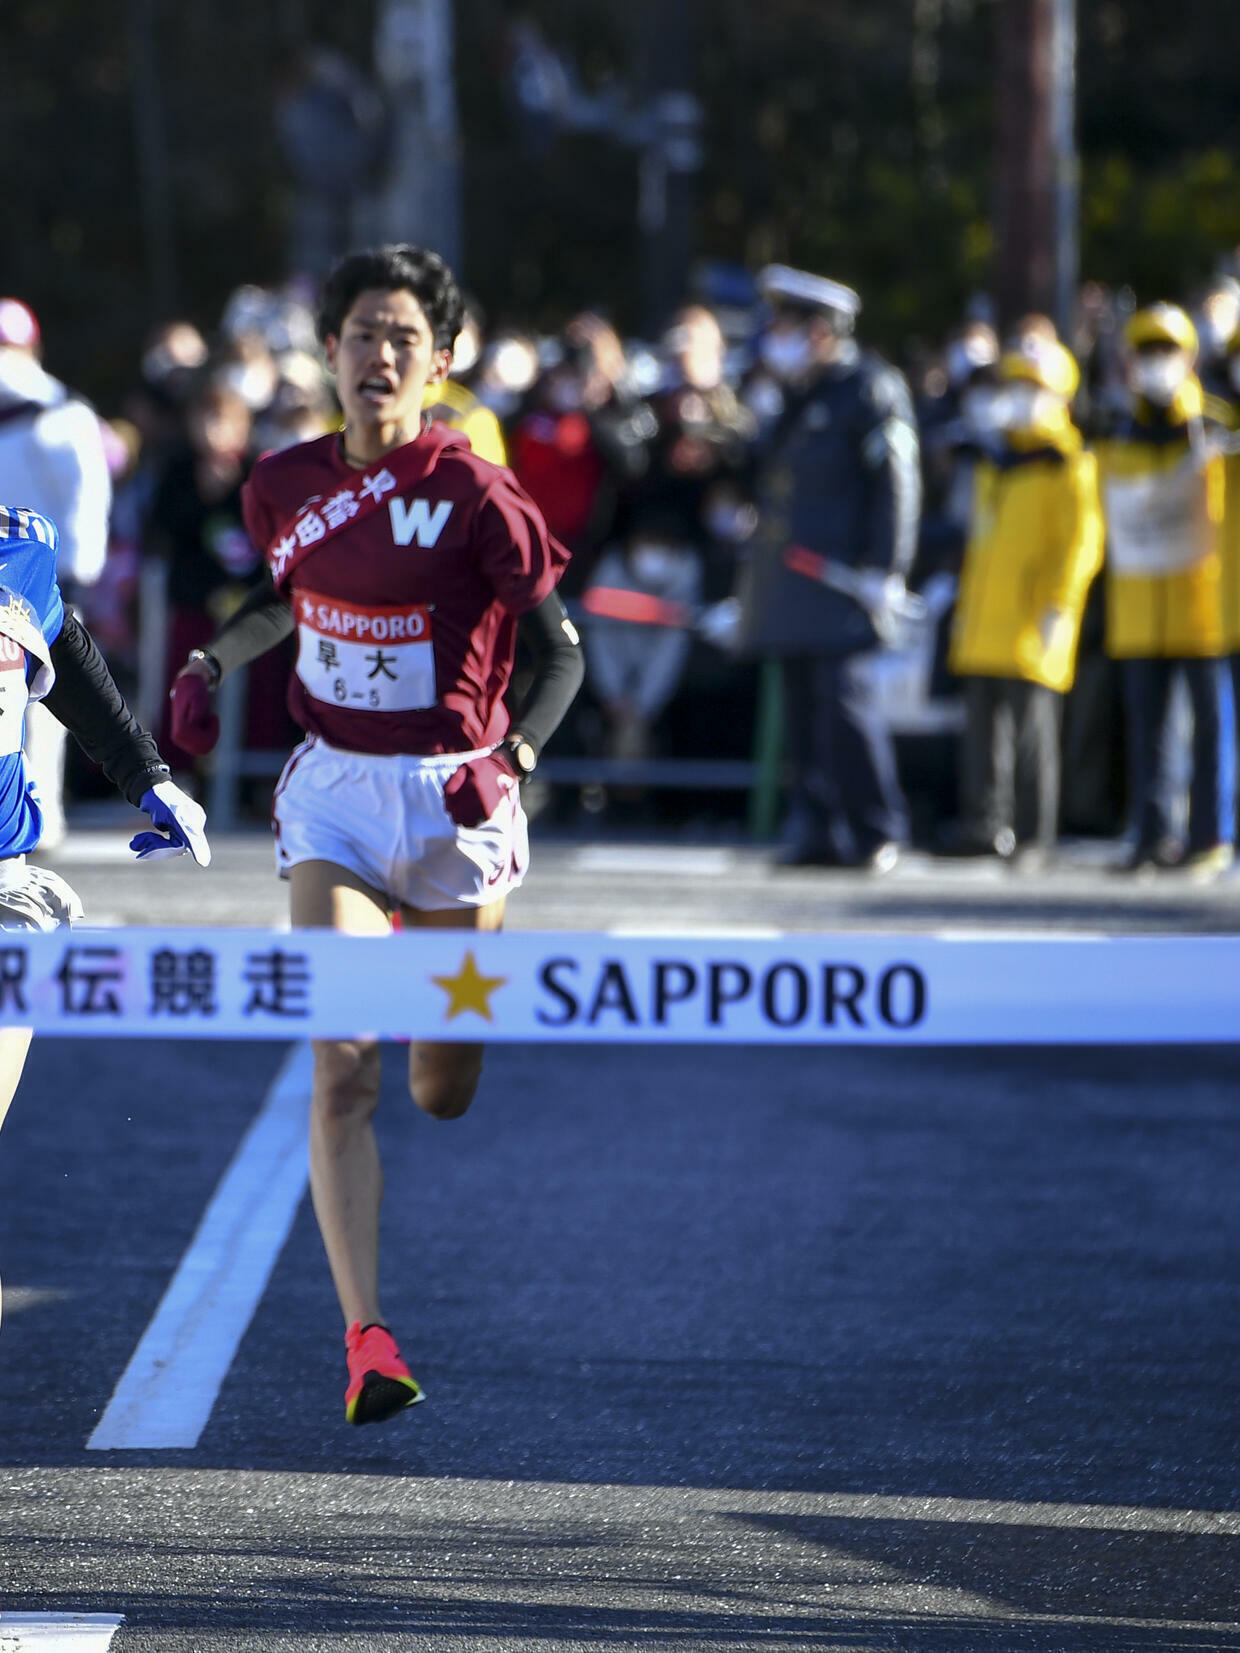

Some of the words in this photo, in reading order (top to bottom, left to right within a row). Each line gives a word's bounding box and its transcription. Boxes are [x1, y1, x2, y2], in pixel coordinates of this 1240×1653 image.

[388, 496, 454, 549] W
[317, 605, 424, 640] SAPPORO
[535, 956, 928, 1029] SAPPORO
